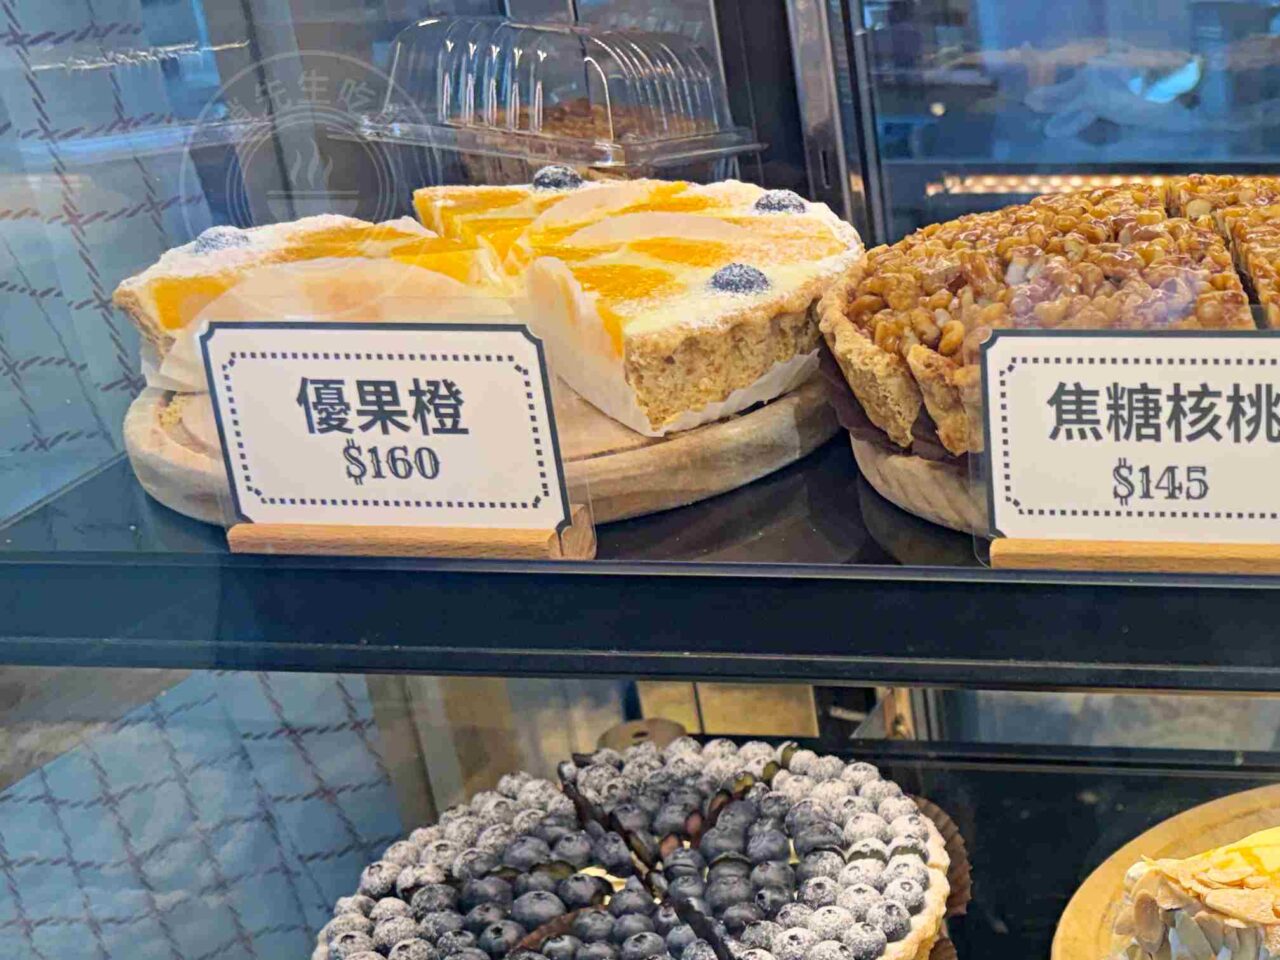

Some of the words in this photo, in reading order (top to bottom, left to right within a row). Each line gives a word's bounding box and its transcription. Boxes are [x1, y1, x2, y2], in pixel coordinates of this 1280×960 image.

[297, 376, 470, 436] 優果橙
[344, 439, 441, 486] $160
[1112, 457, 1210, 507] $145
